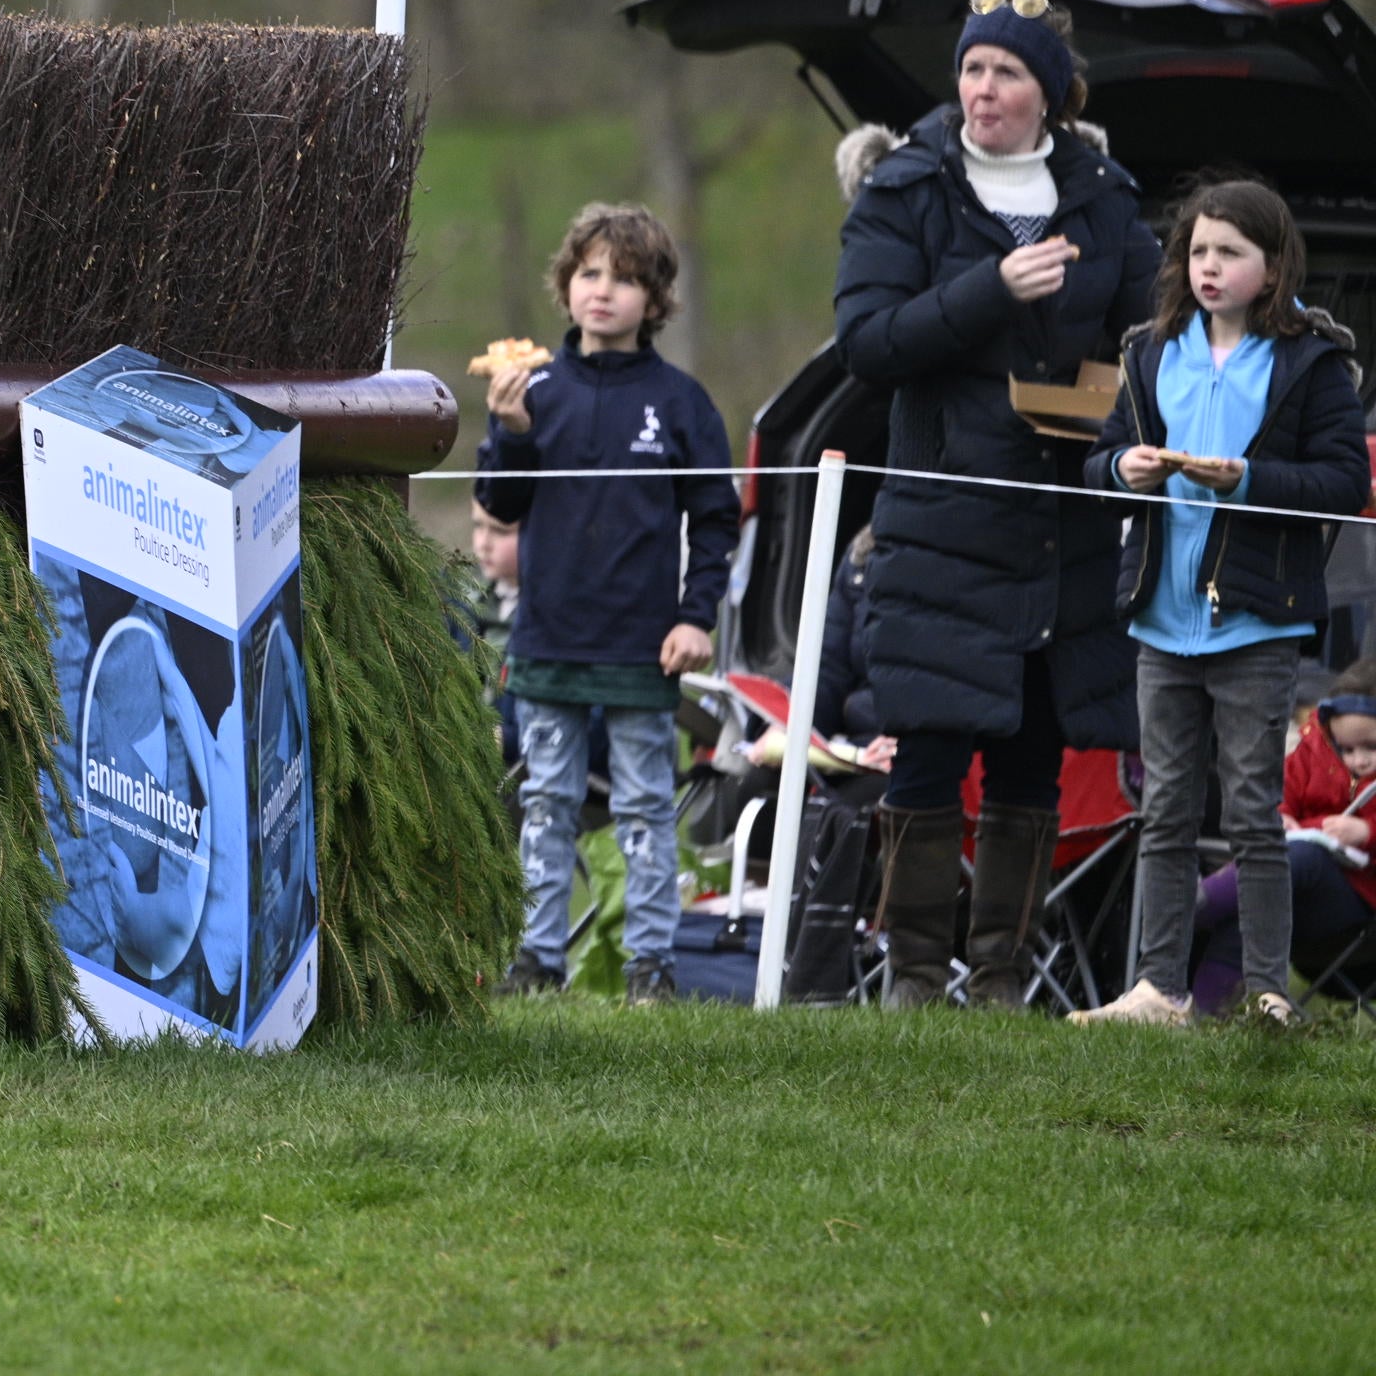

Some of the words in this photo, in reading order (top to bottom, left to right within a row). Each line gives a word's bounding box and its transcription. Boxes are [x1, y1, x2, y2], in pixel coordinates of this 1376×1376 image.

[112, 381, 230, 438] animalintex
[82, 462, 205, 551] animalintex
[134, 527, 170, 563] Poultice
[171, 544, 210, 588] Dressing
[87, 756, 199, 839] animalintex
